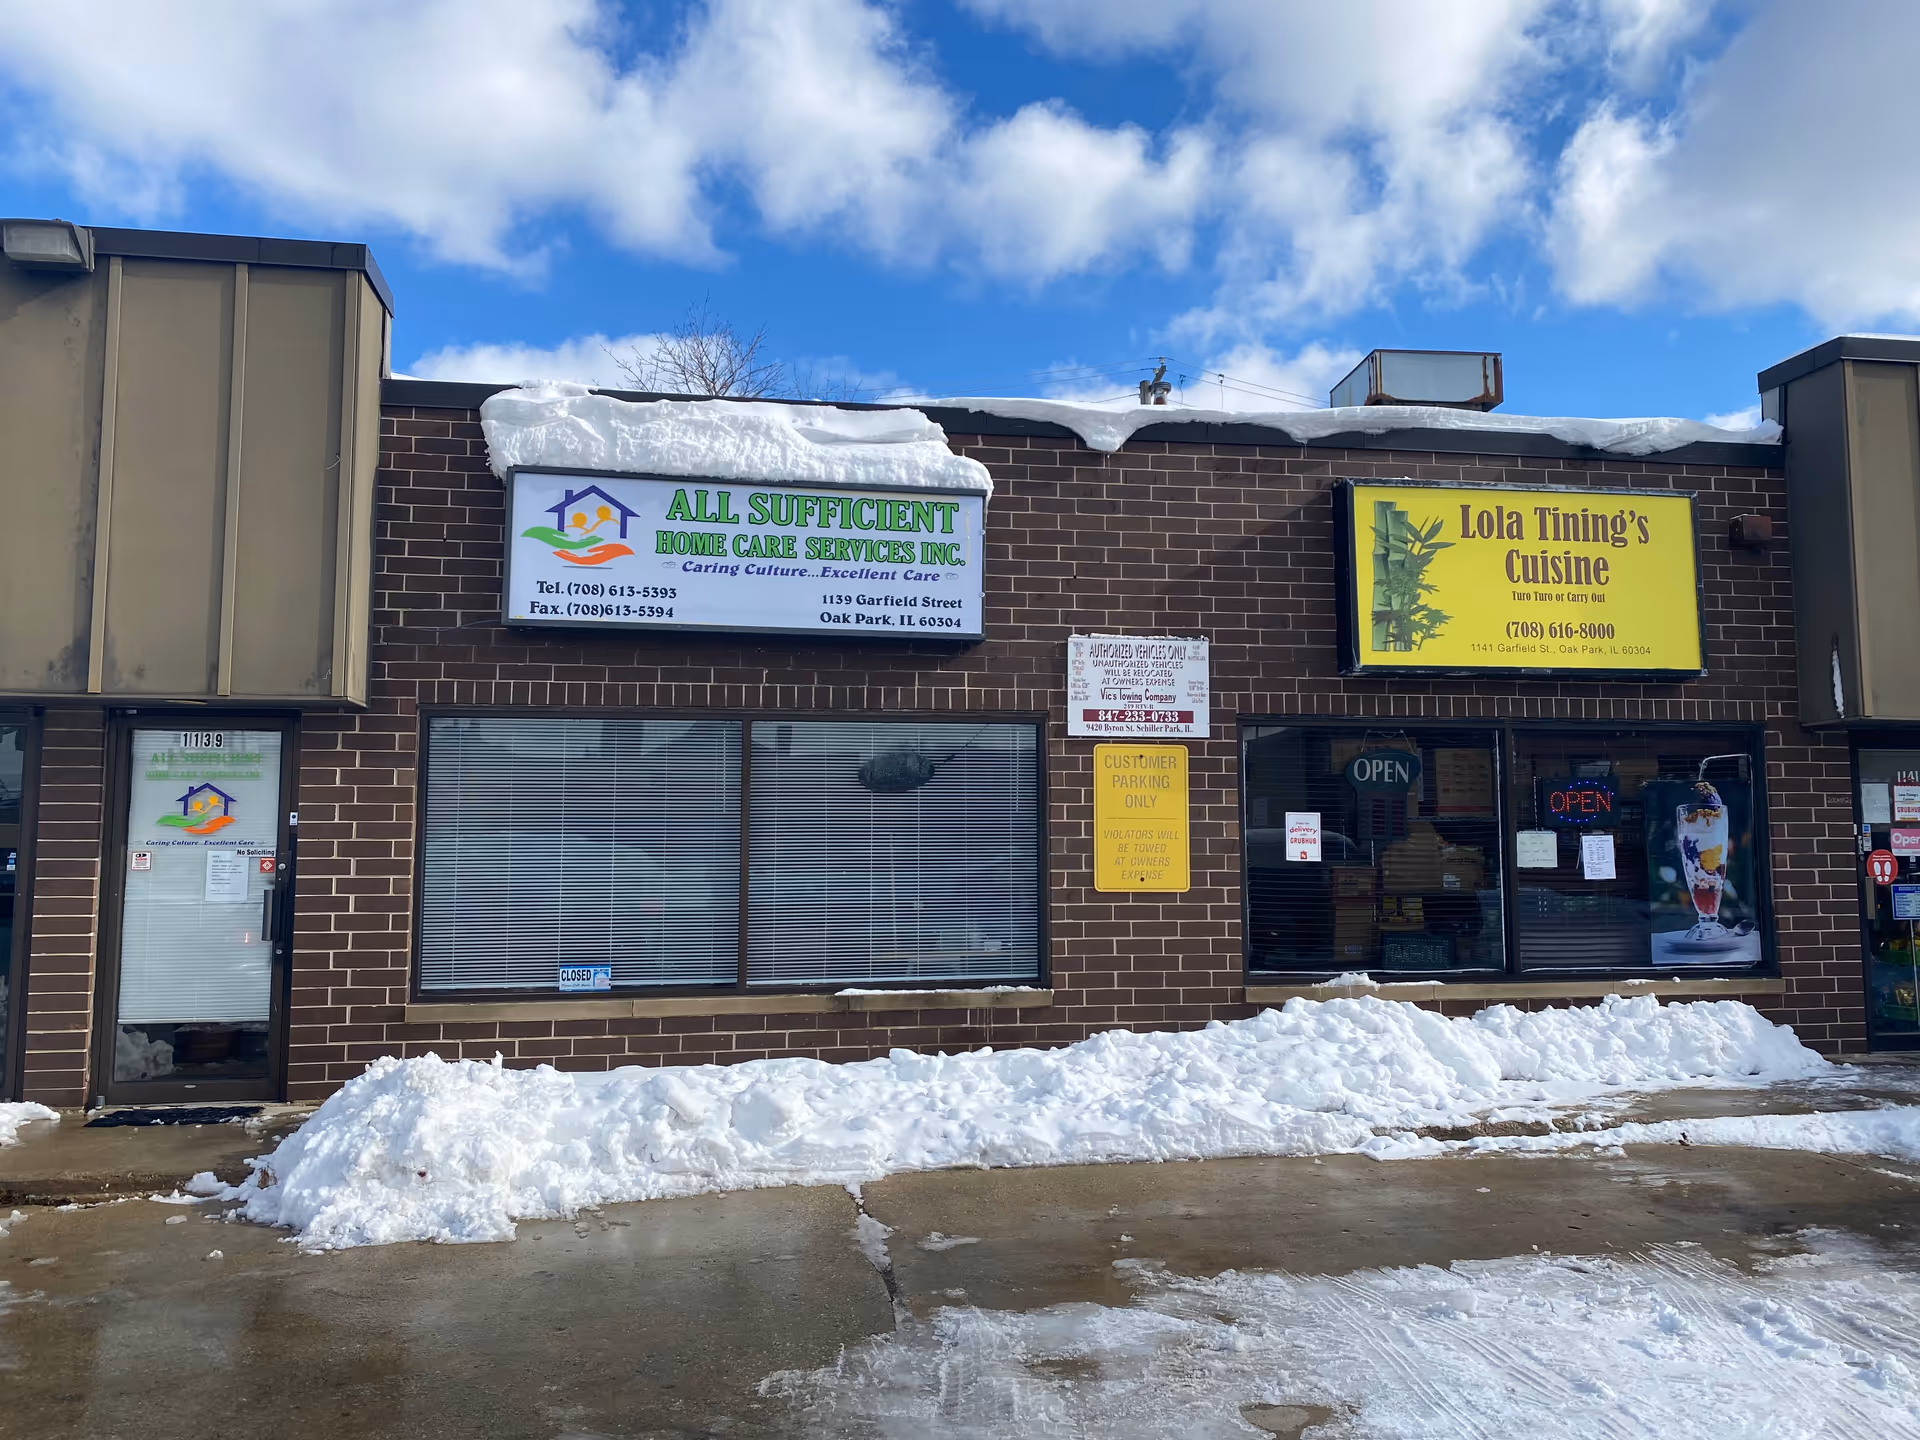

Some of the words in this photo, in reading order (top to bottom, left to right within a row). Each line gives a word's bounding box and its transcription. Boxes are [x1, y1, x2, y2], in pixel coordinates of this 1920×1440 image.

[666, 488, 740, 525] ALL
[748, 492, 960, 534] SUFFICIENT
[1459, 504, 1525, 541] Lola
[1533, 506, 1650, 548] Tining's
[655, 530, 727, 557] HOME
[732, 534, 797, 559] CARE
[805, 536, 916, 565] SERVICES
[920, 541, 967, 567] INC.
[682, 560, 740, 577] Caring
[903, 569, 941, 582] Care
[1505, 548, 1610, 586] Cuisine
[536, 580, 564, 594] Tel.
[567, 582, 605, 598] (708)
[608, 585, 677, 599] 613-5393
[822, 594, 852, 605] 1139
[856, 593, 917, 607] Garfield
[921, 596, 963, 609] Street
[1511, 590, 1531, 601] Turo
[1533, 591, 1553, 602] Turo
[1555, 592, 1564, 602] or
[1567, 591, 1588, 604] Carry
[1591, 592, 1606, 603] Out
[529, 601, 564, 615] Fax.
[820, 611, 851, 624] Oak
[855, 613, 895, 626] Park,
[899, 614, 916, 626] IL
[919, 617, 962, 628] 60304
[1505, 621, 1544, 640] (708)
[1548, 621, 1615, 640] 616-8000
[1089, 643, 1133, 659] AUTHORIZED
[1135, 644, 1167, 660] VEHICLES
[1168, 645, 1187, 660] ONLY
[1471, 643, 1493, 653] 1141
[1497, 643, 1536, 653] Garfield
[1559, 644, 1578, 654] Oak
[1581, 644, 1607, 655] Park,
[1622, 646, 1651, 655] 60304
[1092, 660, 1149, 668] UNAUTHORIZED
[1151, 660, 1184, 669] VEHICLES
[1104, 669, 1121, 677] WILL
[1123, 669, 1131, 677] BE
[1133, 669, 1173, 677] RELOCATED
[1101, 677, 1110, 685] AT
[1112, 677, 1144, 686] OWNERS
[1145, 678, 1176, 686] EXPENSE
[1119, 688, 1143, 703] Towing
[1144, 688, 1176, 703] Company
[1098, 710, 1179, 722] 847-233-0733
[1086, 723, 1103, 732] 9420
[1104, 723, 1124, 733] Byron
[1125, 724, 1135, 732] St.
[1136, 724, 1164, 732] Schiller
[183, 732, 223, 747] 1139
[1104, 755, 1177, 769] CUSTOMER
[1353, 758, 1409, 783] OPEN
[1112, 774, 1170, 788] PARKING
[1125, 794, 1157, 808] ONLY
[1549, 791, 1611, 812] OPEN
[1103, 830, 1154, 840] VIOLATORS
[1157, 830, 1180, 840] WILL
[1289, 825, 1317, 834] delivery
[1117, 843, 1129, 853] BE
[1134, 843, 1167, 853] TOWED
[1114, 857, 1126, 866] AT
[1130, 857, 1171, 867] OWNERS
[1121, 870, 1163, 880] EXPENSE
[561, 969, 591, 981] CLOSED
